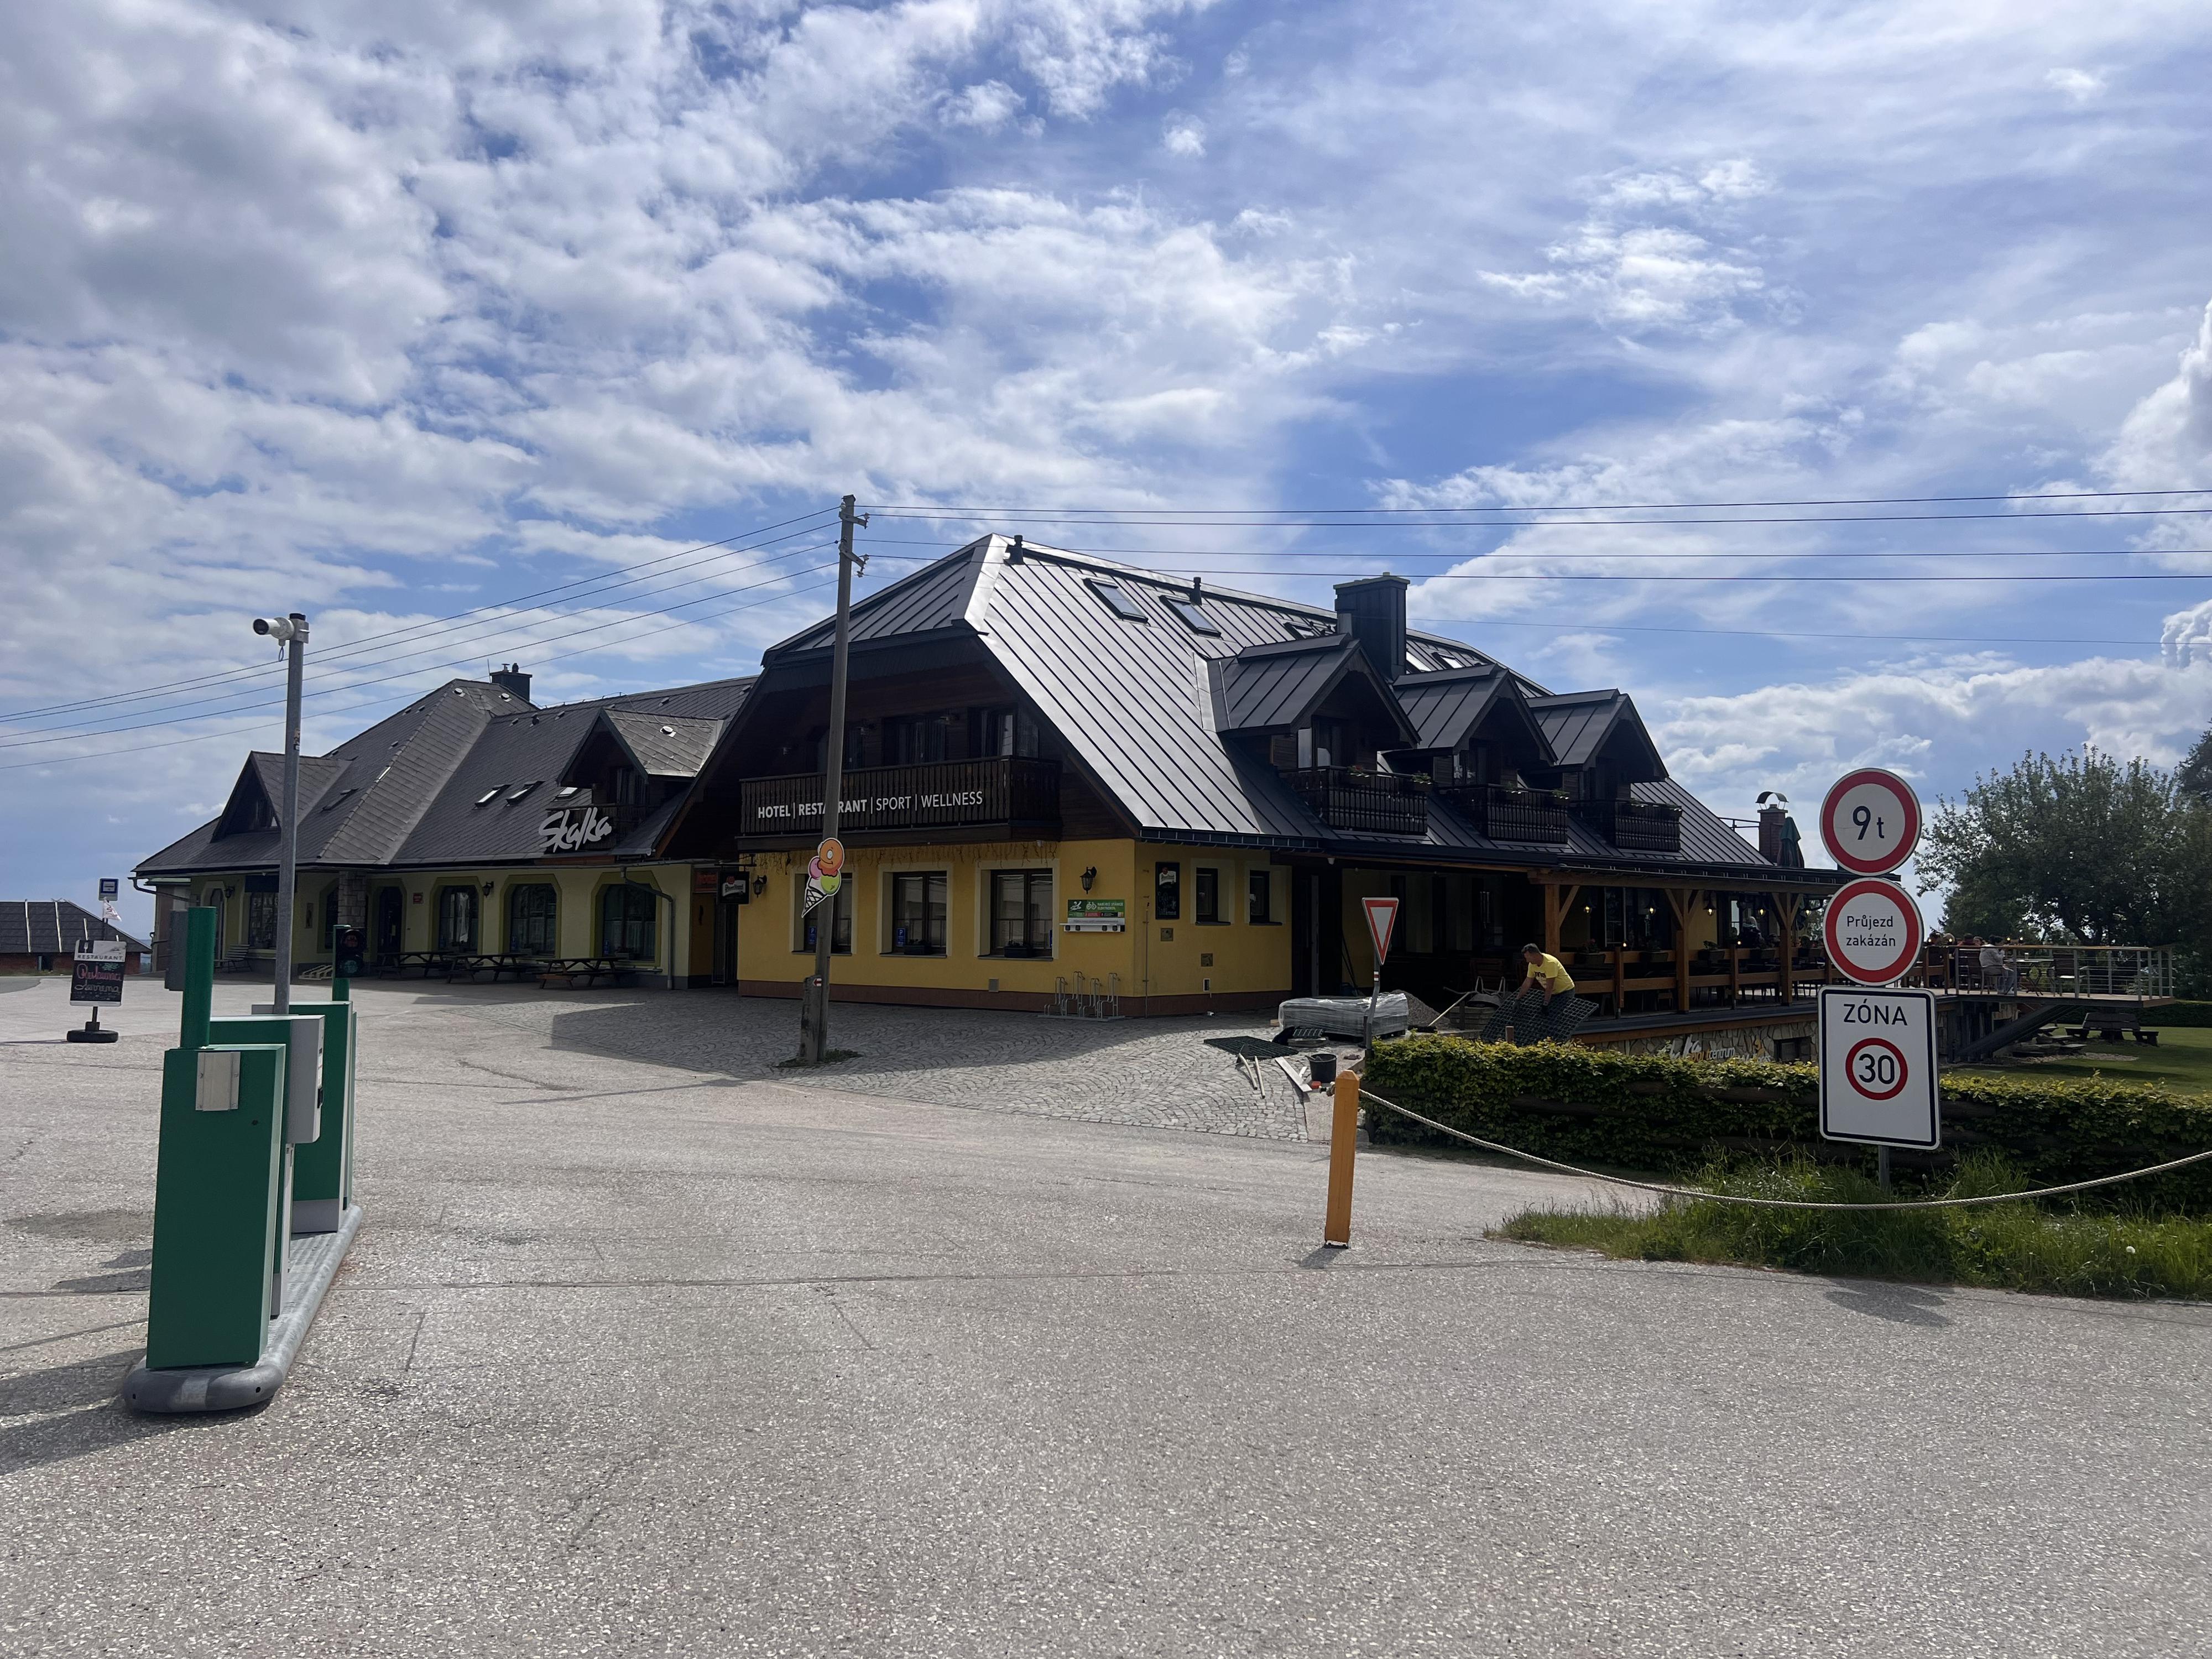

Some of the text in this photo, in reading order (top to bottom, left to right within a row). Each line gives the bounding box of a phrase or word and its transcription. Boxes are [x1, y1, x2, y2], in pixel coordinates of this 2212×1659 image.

[759, 791, 983, 818] HOTEL RESTRANT SPORT WELLNESS
[539, 807, 612, 853] Skalka
[1853, 806, 1885, 841] 9 t
[1846, 914, 1893, 931] Průjezd
[1845, 931, 1897, 947] zakázán
[1843, 998, 1908, 1026] ZÓNA
[1858, 1053, 1896, 1085] 30
